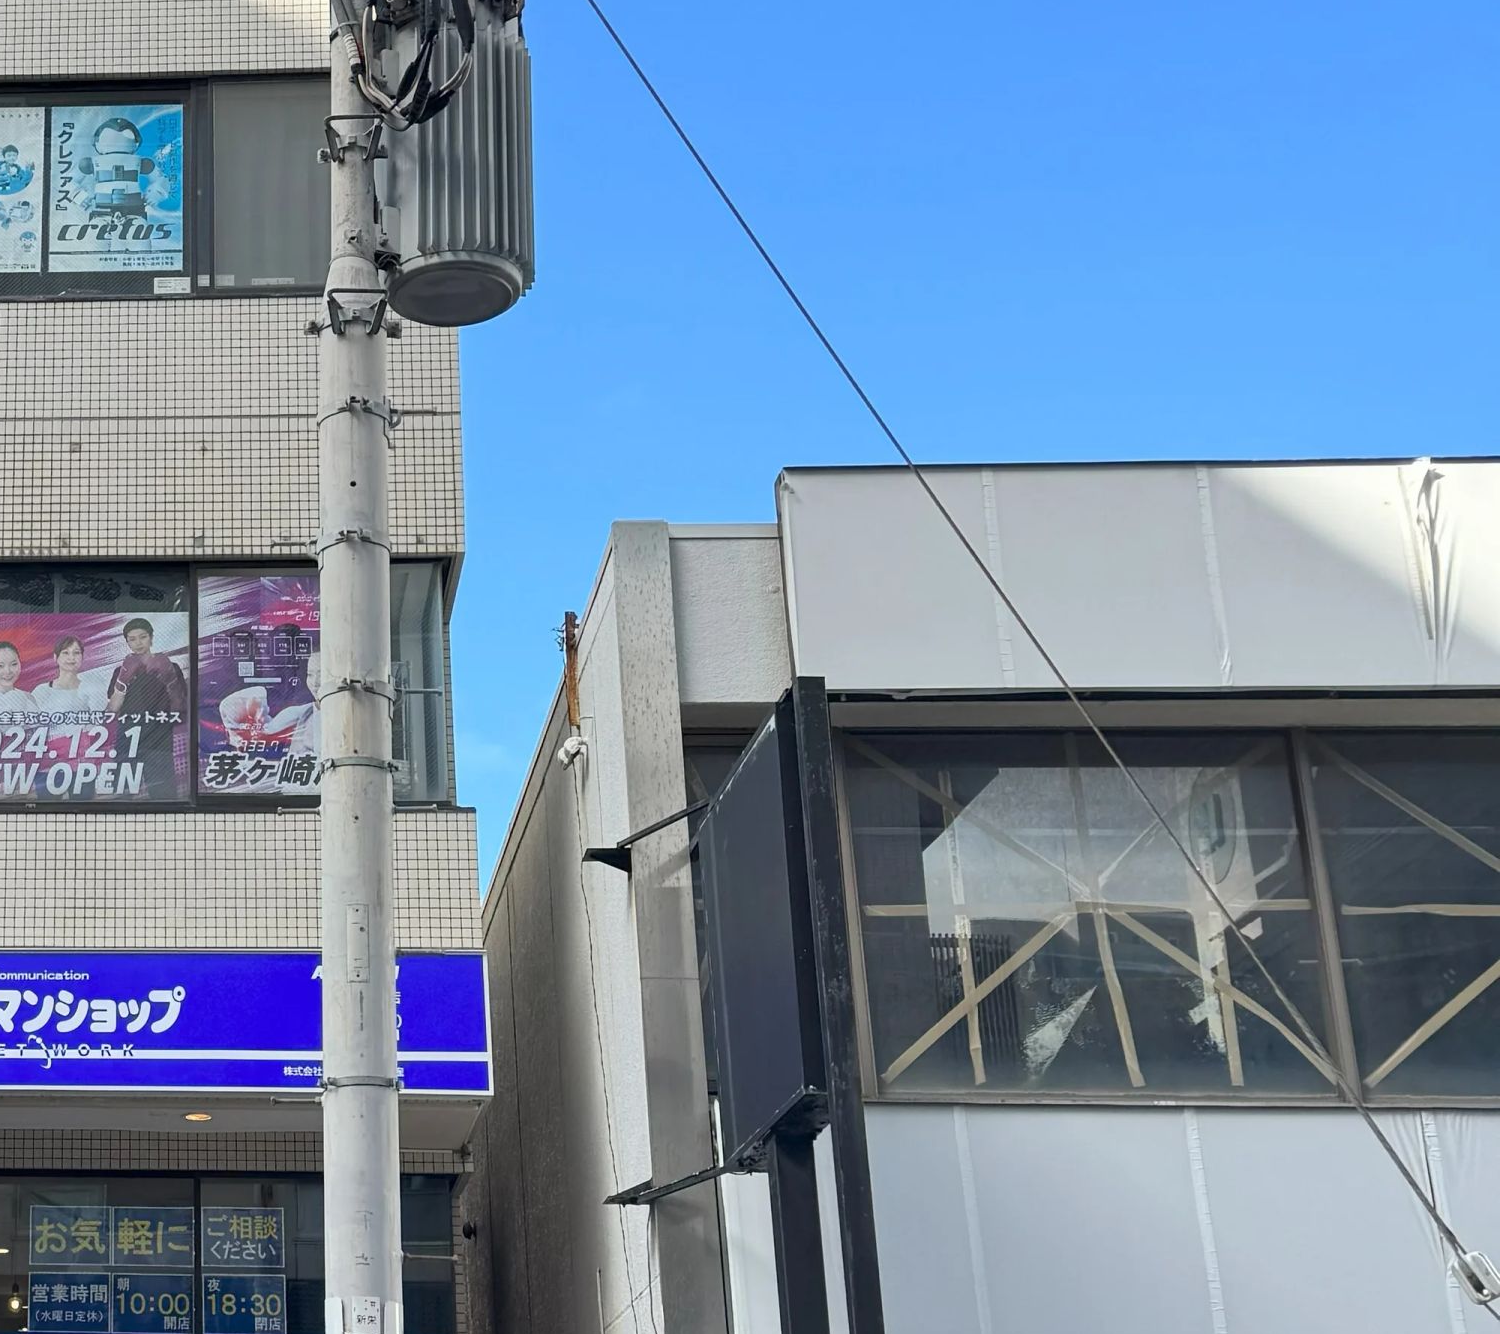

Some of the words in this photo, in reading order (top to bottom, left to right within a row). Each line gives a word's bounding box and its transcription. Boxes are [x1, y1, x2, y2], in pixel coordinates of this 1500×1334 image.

[45, 762, 143, 796] OPEN
[204, 752, 321, 787] 茅ケ崎
[207, 1215, 279, 1240] ご相談
[210, 1240, 277, 1261] ください
[31, 1283, 108, 1304] 営業時間
[117, 1277, 130, 1291] 朝
[207, 1277, 221, 1291] 夜
[116, 1293, 190, 1316] 10:00
[207, 1294, 282, 1316] 18:30
[163, 1317, 191, 1331] 開店
[254, 1317, 282, 1332] 閉店
